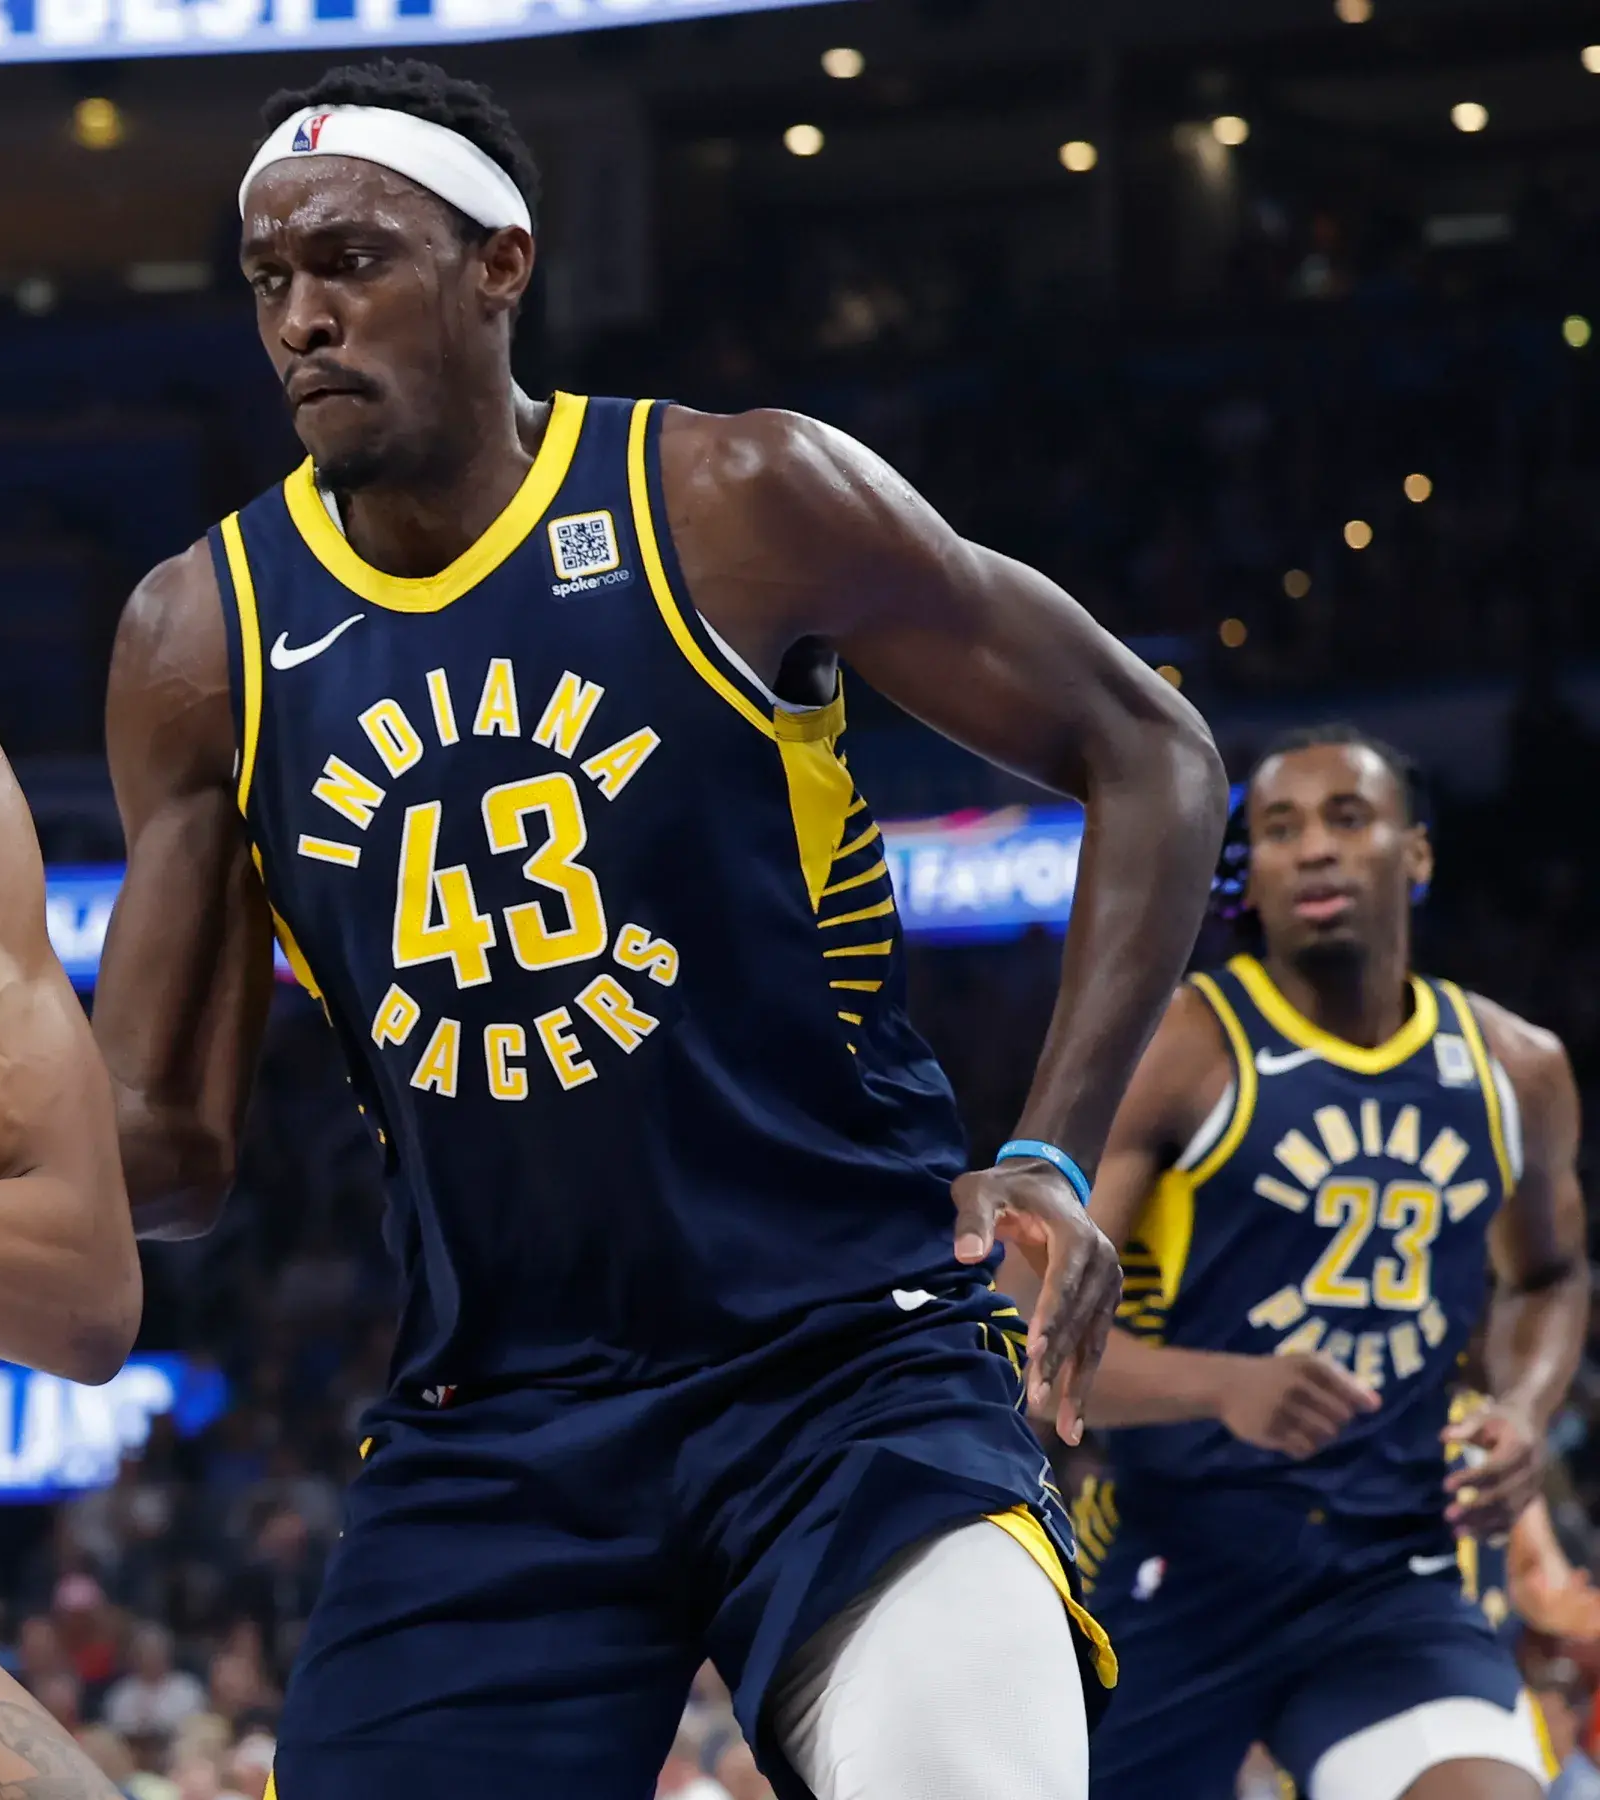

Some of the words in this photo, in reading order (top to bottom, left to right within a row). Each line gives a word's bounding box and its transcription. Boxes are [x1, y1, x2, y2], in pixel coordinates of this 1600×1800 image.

[551, 569, 630, 598] spokenote
[297, 658, 661, 868] INDIANA
[392, 771, 608, 990] 43
[371, 923, 680, 1101] PACERS
[1252, 1097, 1490, 1224] INDIANA
[1301, 1174, 1444, 1311] 23
